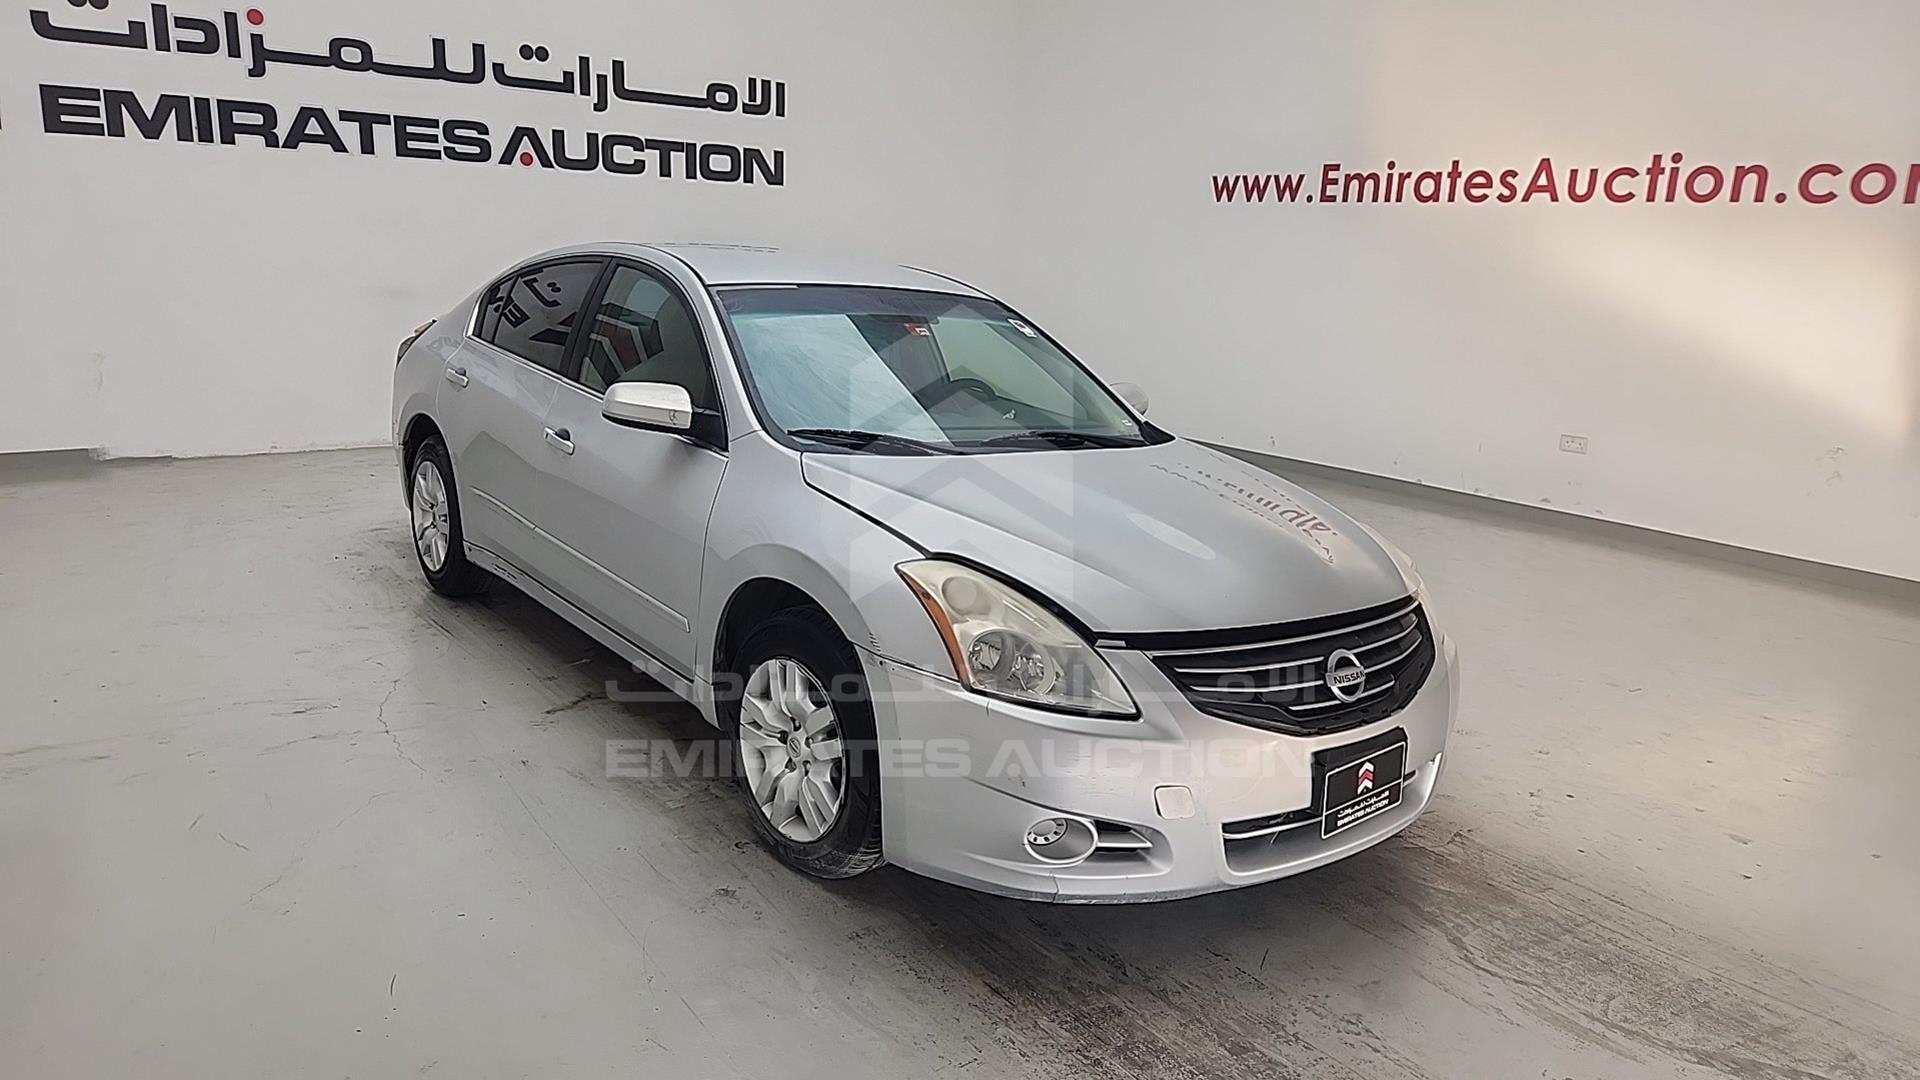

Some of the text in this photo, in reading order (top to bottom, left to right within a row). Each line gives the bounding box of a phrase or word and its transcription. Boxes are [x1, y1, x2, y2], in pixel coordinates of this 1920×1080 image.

[492, 43, 786, 118] الامارات
[38, 83, 785, 186] EMIRATES AUCTION
[1333, 670, 1365, 684] NISSAN
